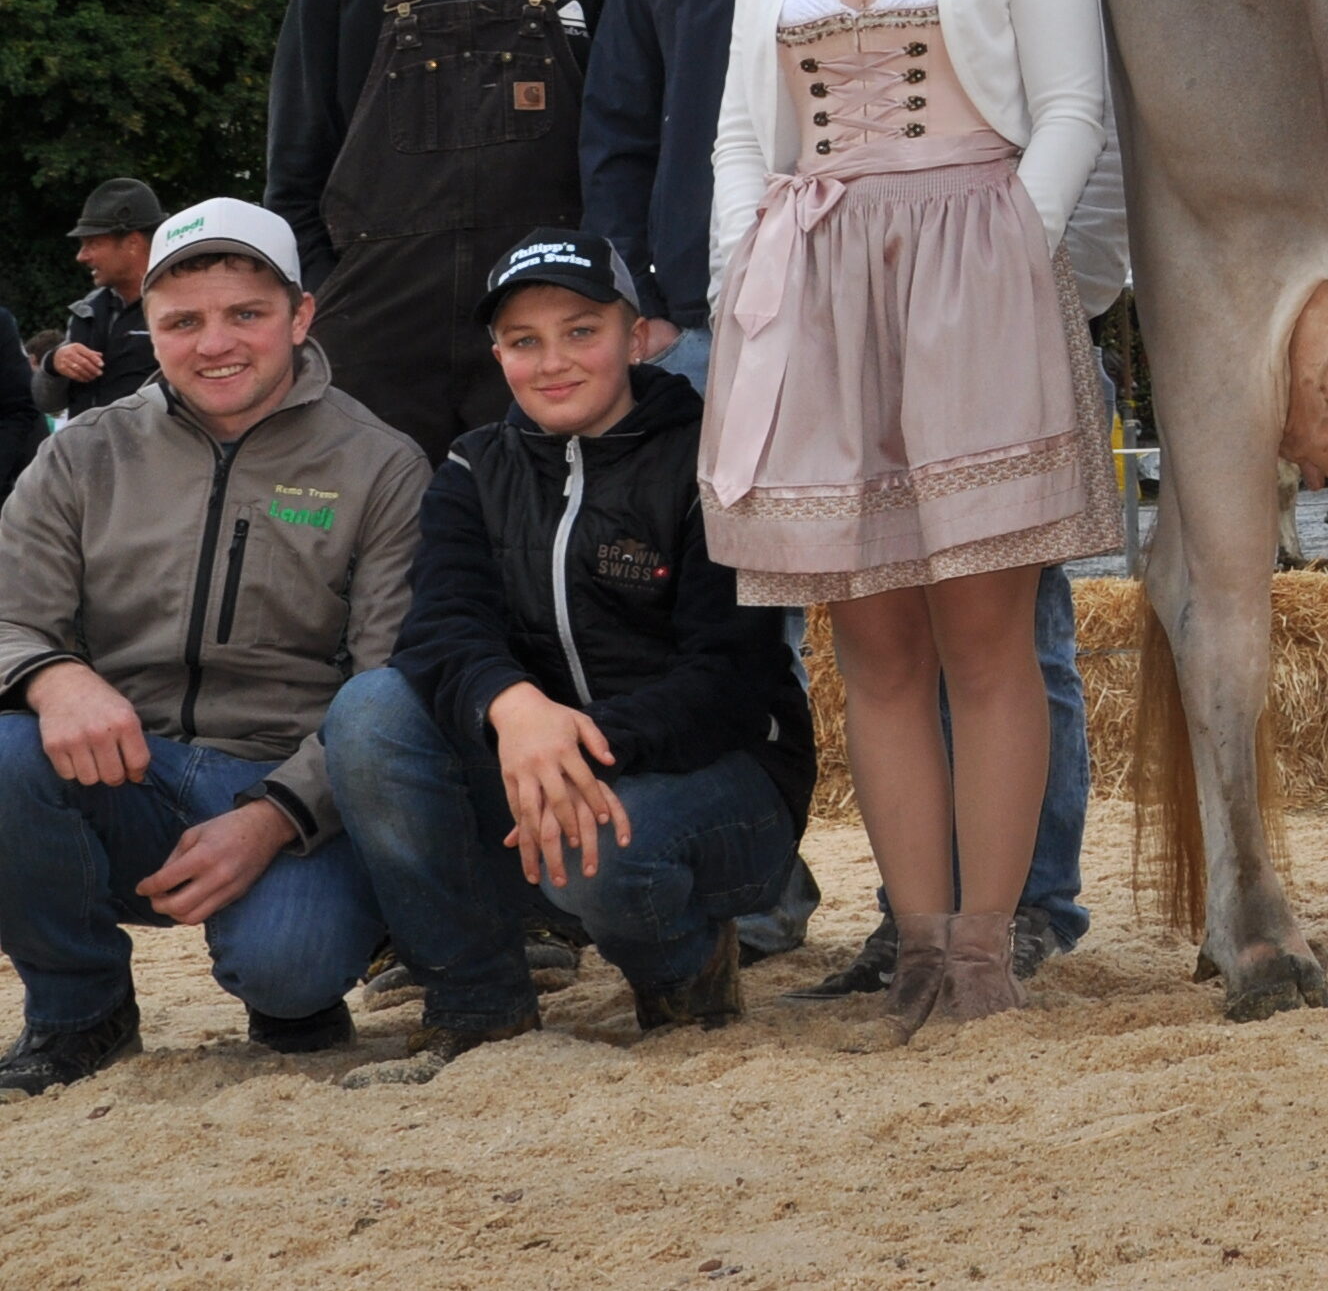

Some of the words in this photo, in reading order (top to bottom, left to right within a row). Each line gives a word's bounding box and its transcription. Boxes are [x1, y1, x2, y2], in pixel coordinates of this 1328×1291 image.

[166, 217, 204, 240] Landi
[509, 242, 575, 265] Philipp's
[544, 253, 592, 267] Swiss
[269, 500, 335, 530] Landi
[598, 560, 652, 581] SWISS
